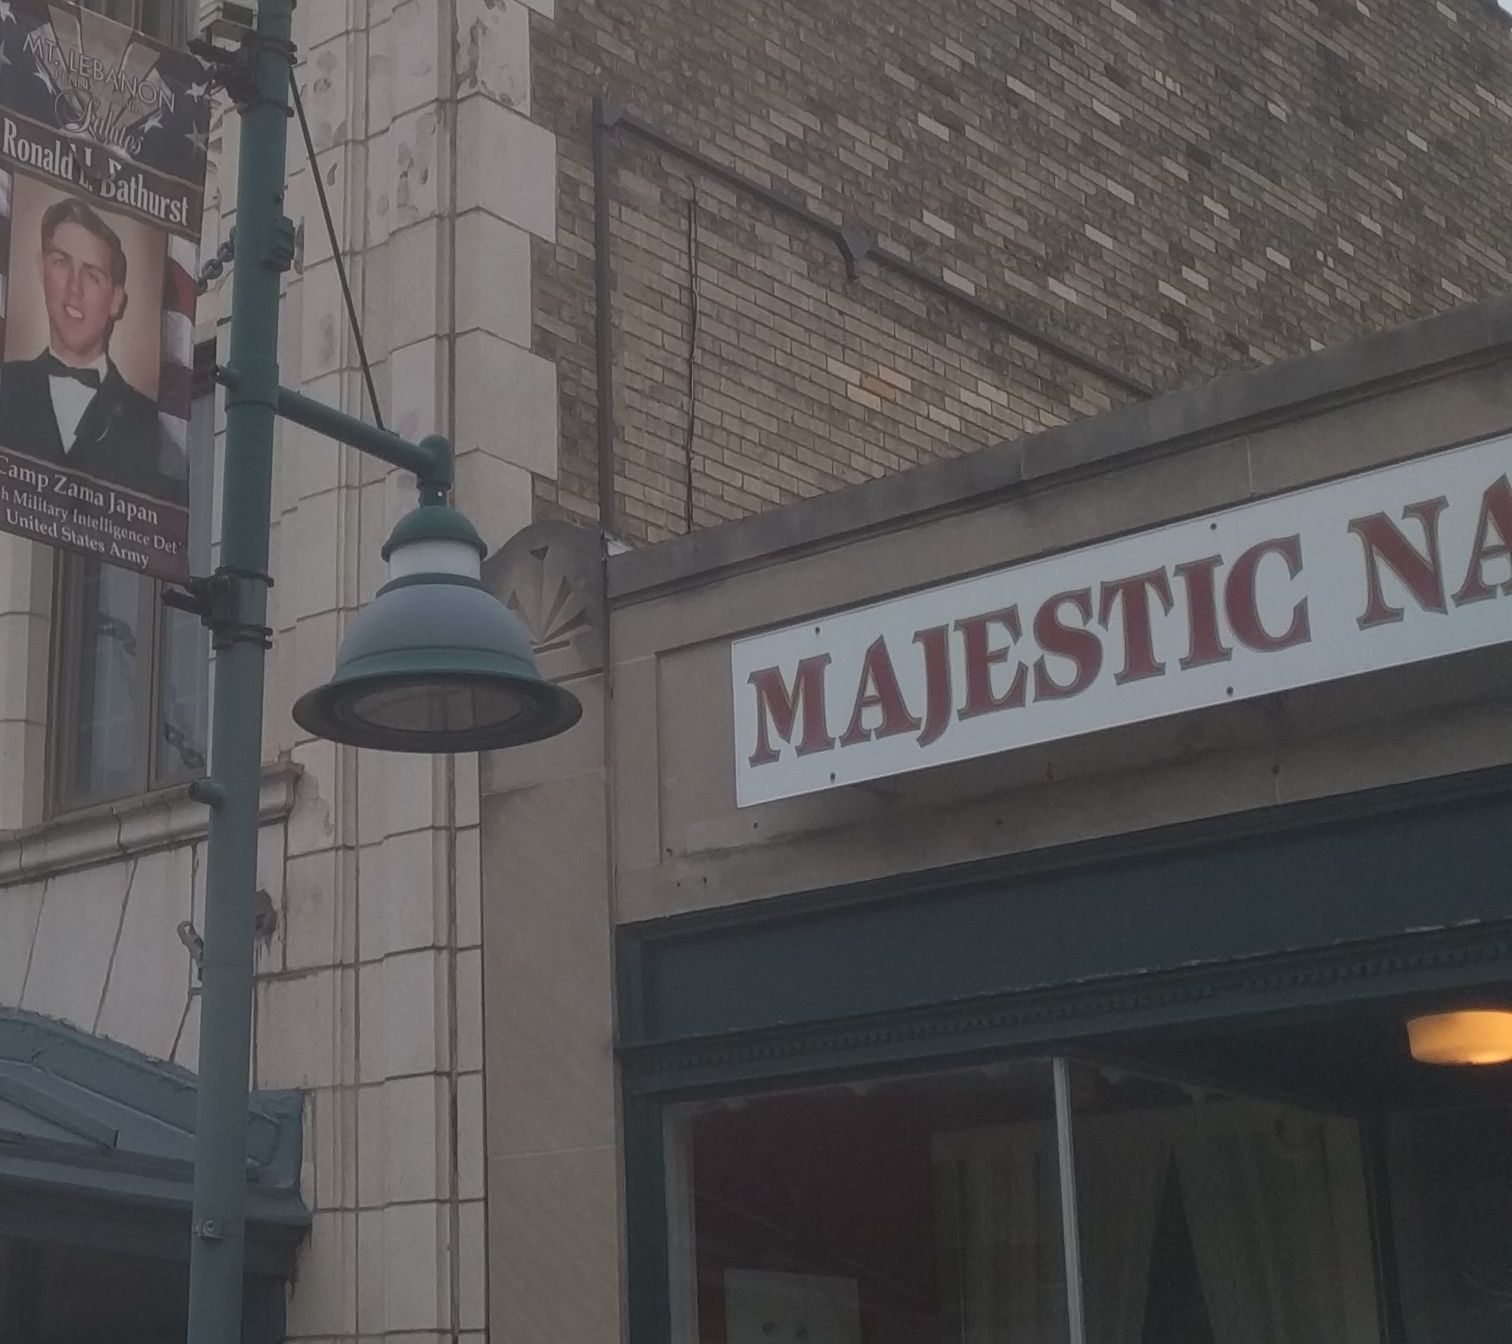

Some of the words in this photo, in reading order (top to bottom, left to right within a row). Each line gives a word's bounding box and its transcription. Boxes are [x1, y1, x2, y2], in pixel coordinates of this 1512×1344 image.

[23, 33, 59, 65] MT.
[69, 50, 175, 113] LEBANON
[55, 89, 144, 154] Salutes
[2, 117, 75, 180] Ronald
[100, 158, 188, 226] Bathurst
[13, 489, 68, 521] Military
[73, 509, 150, 546] Intelligence
[53, 474, 104, 506] Zama
[108, 493, 159, 525] Japan
[6, 509, 58, 538] United
[61, 524, 105, 552] States
[109, 542, 149, 569] Army
[747, 534, 1313, 769] MAJESTIC
